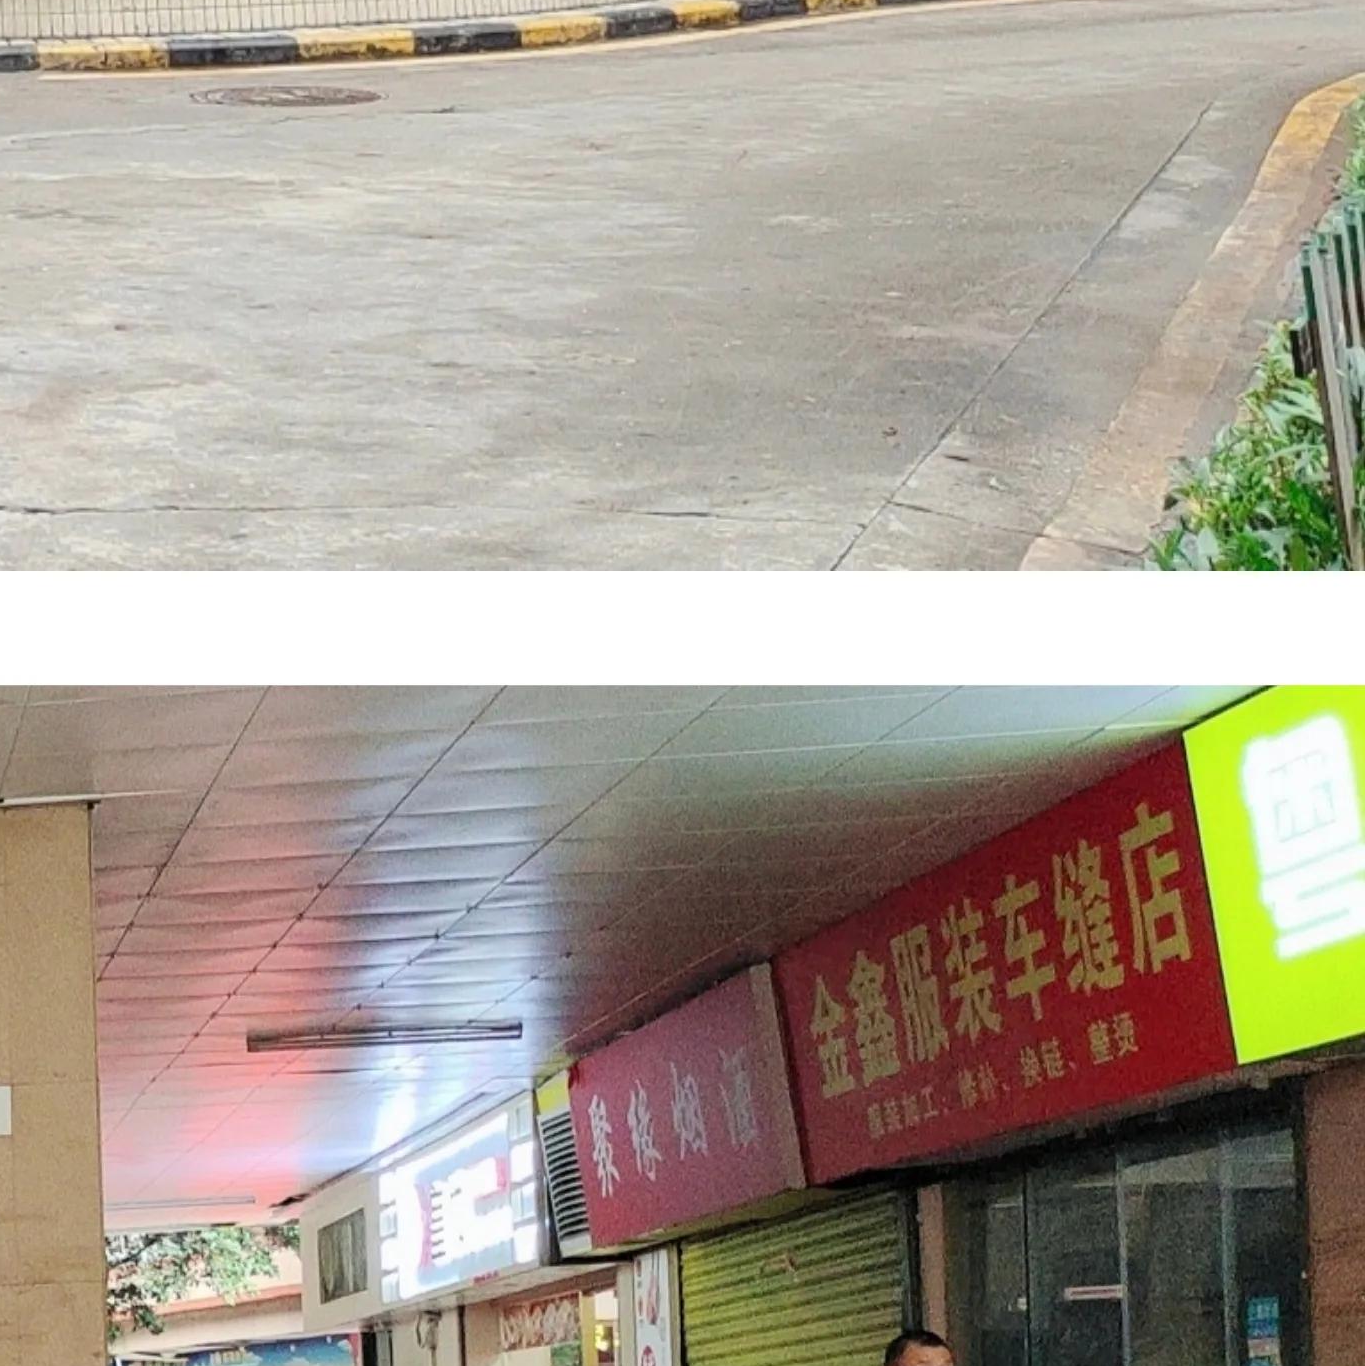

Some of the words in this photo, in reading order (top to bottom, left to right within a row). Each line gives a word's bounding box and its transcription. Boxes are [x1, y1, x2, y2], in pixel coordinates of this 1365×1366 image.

[807, 801, 1195, 1101] 金鑫服装车缝店
